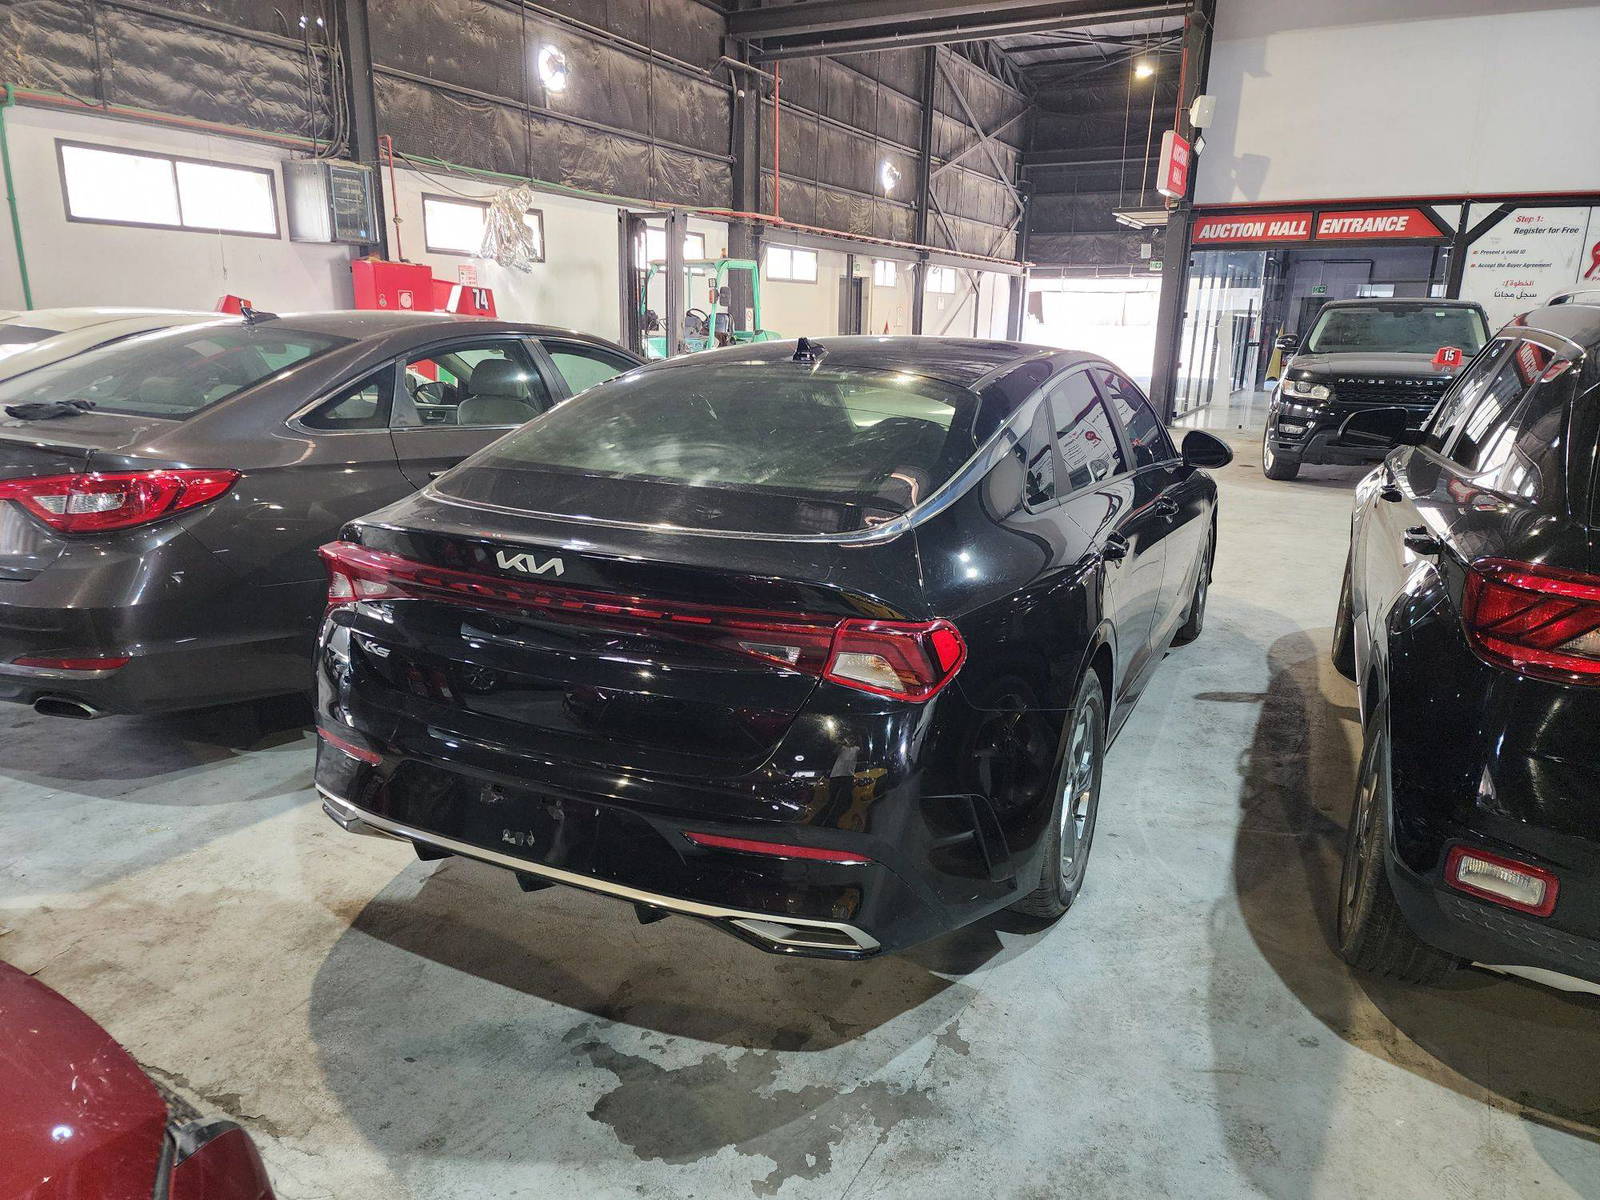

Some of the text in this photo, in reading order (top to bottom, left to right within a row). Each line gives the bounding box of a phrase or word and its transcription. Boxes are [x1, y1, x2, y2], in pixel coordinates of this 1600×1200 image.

[1319, 216, 1409, 234] ENTRANCE
[1515, 215, 1534, 224] Step
[1199, 220, 1307, 239] AUCTION HALL
[1513, 227, 1546, 235] Register
[1561, 226, 1580, 234] Free
[1444, 350, 1455, 361] 15
[495, 550, 565, 577] KIA
[365, 640, 392, 658] K5
